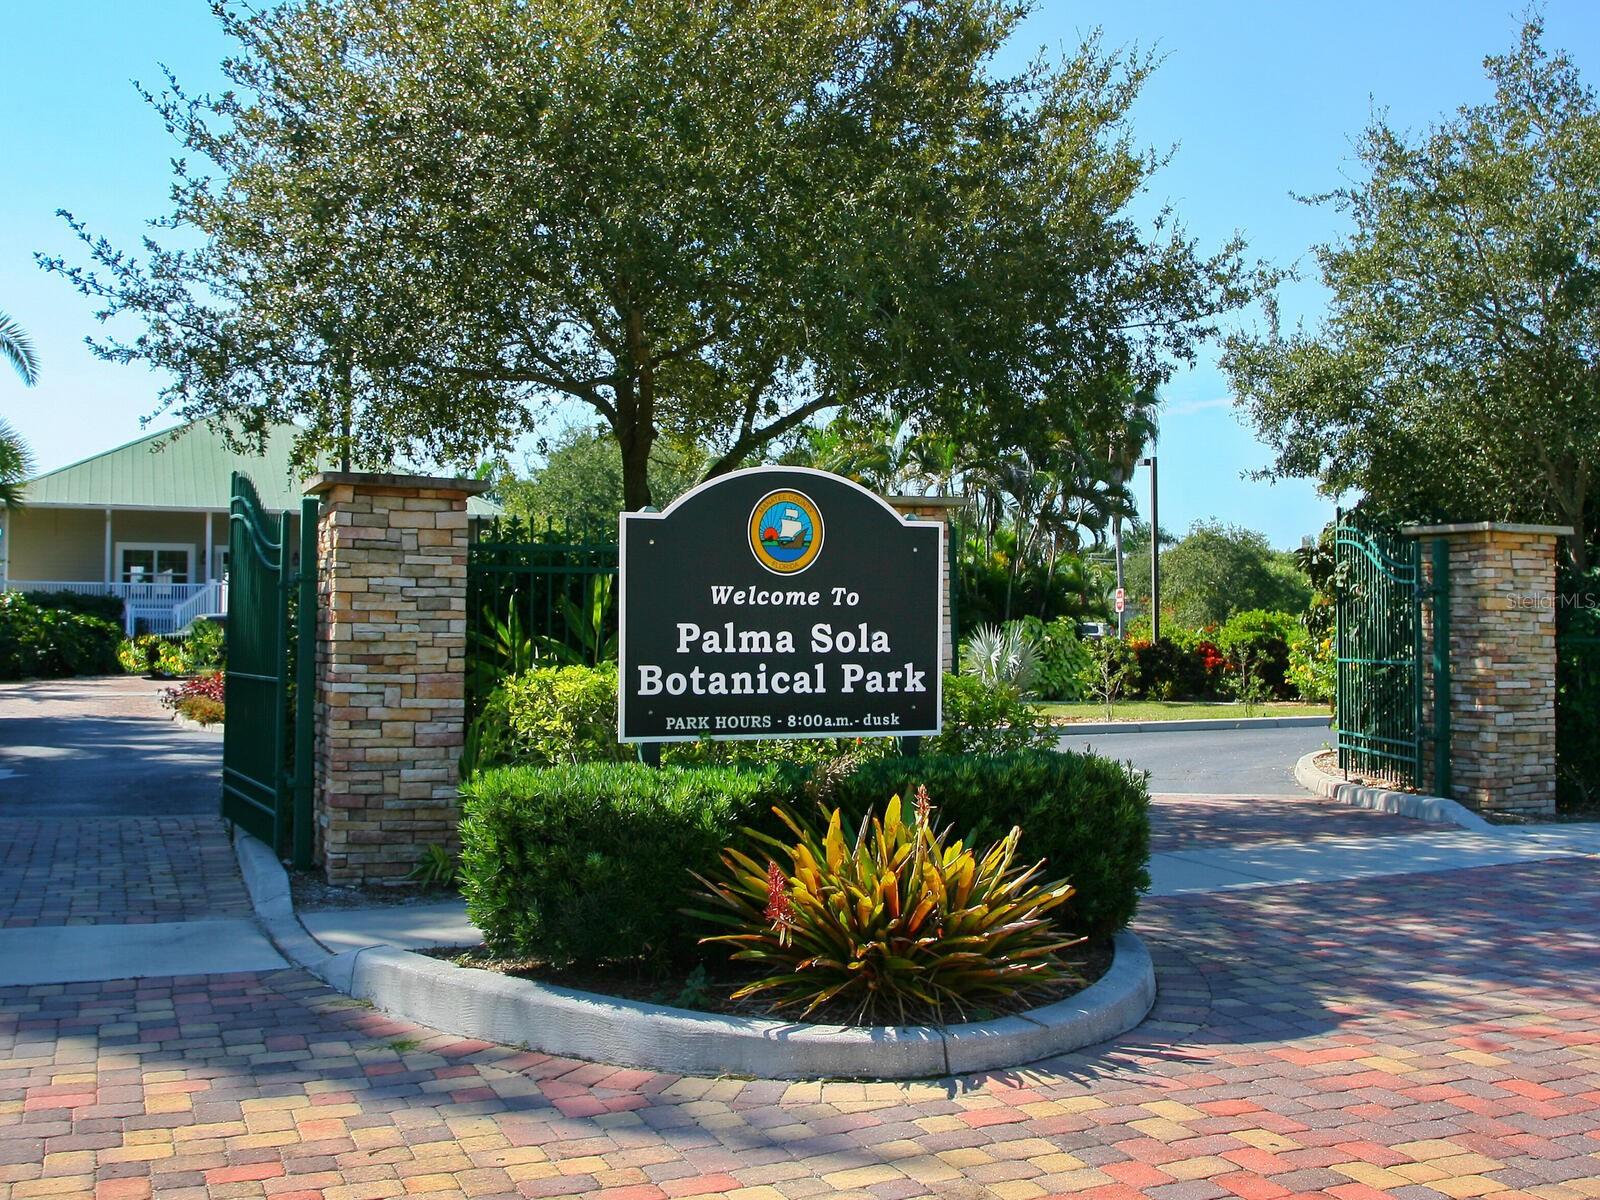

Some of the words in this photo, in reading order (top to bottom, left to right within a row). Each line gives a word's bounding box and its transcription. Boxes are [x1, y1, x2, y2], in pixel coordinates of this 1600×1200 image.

[711, 586, 820, 605] Welcome
[831, 588, 859, 606] To
[677, 622, 795, 653] Palma
[811, 623, 890, 653] Sola
[638, 663, 826, 695] Botanical
[841, 663, 926, 692] Park
[665, 716, 710, 730] PARK
[715, 715, 772, 729] HOURS
[863, 712, 900, 726] dusk
